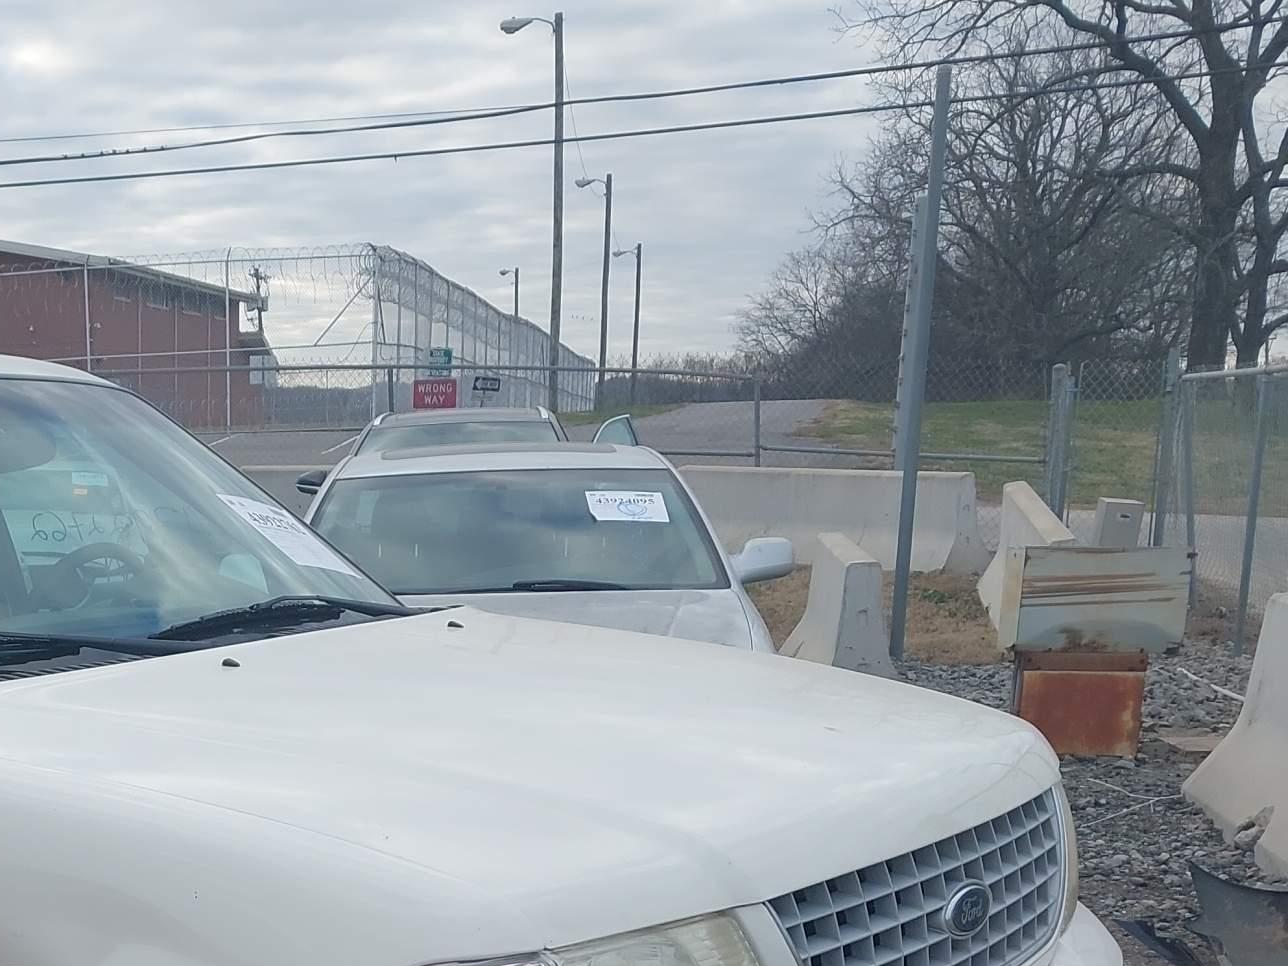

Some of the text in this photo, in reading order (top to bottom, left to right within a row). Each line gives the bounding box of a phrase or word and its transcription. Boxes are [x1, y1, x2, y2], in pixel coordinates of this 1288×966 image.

[417, 383, 453, 393] WRONG
[423, 394, 446, 405] WAY
[960, 895, 984, 925] Ford
